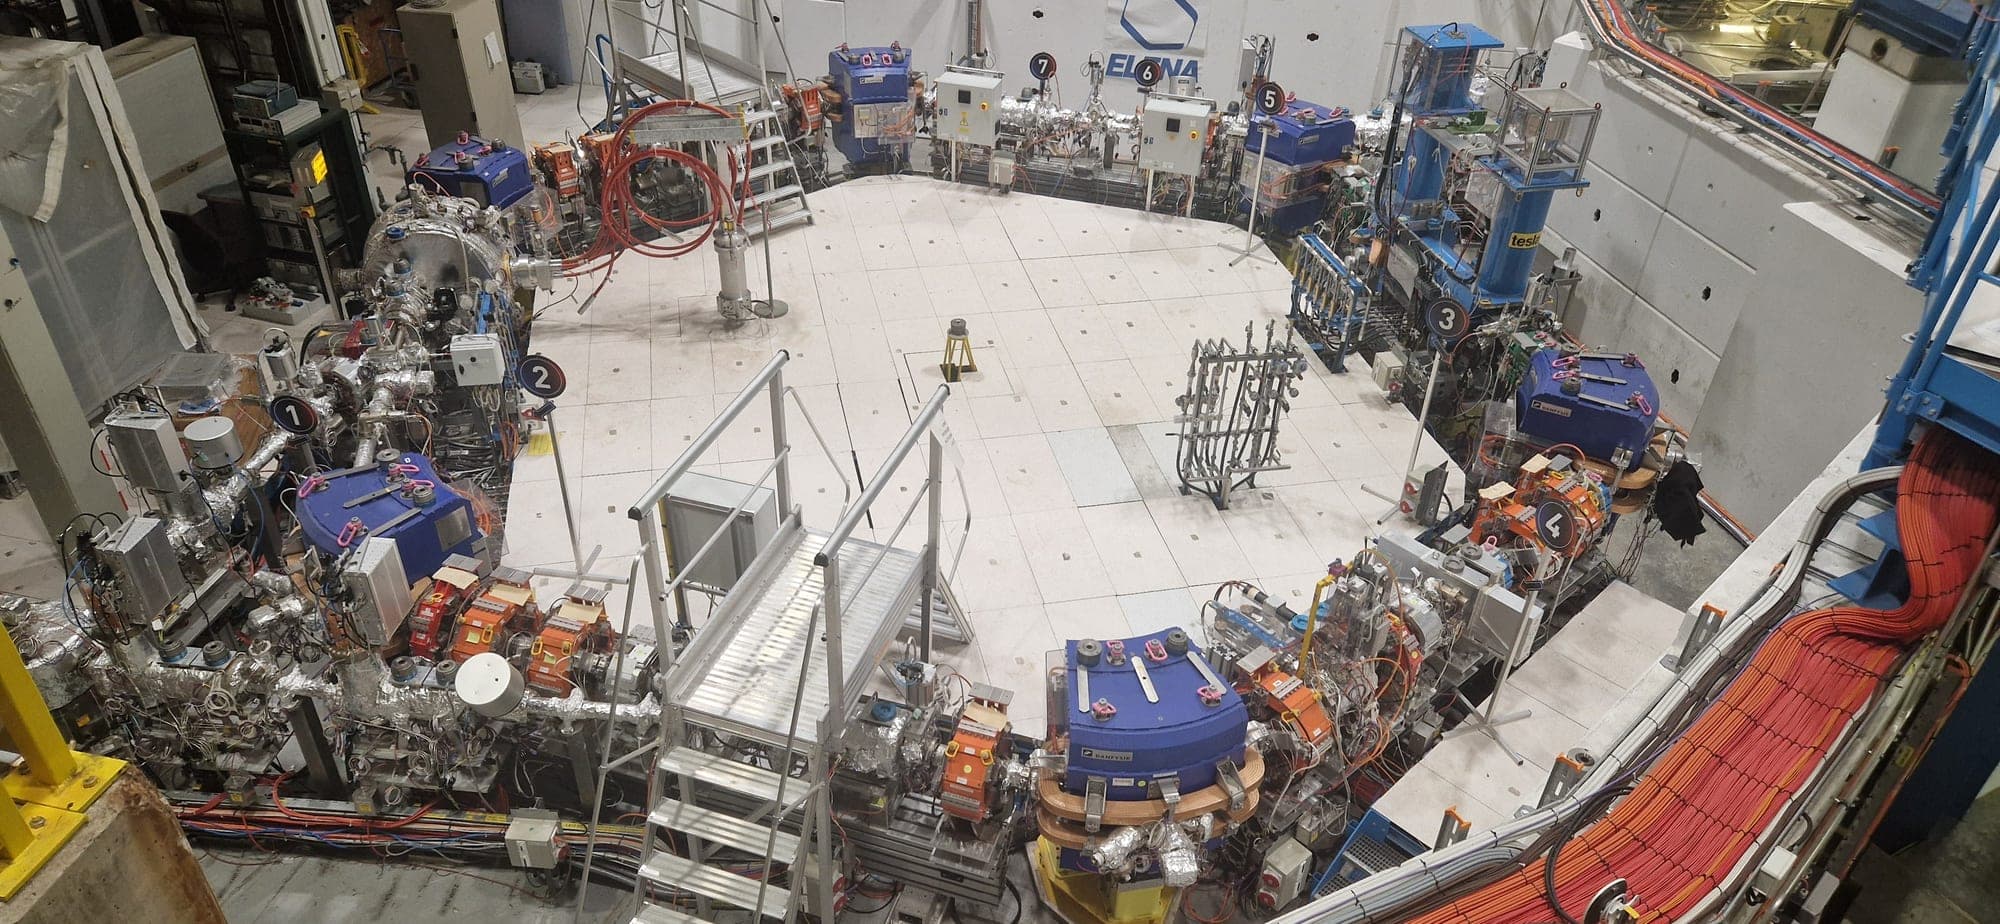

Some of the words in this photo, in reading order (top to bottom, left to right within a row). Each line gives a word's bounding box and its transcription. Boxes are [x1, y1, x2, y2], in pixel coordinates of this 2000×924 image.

[1038, 59, 1049, 74] 7
[1142, 65, 1153, 81] 6
[1264, 90, 1276, 108] 5
[1438, 307, 1455, 330] 3
[532, 365, 551, 389] 2
[285, 405, 300, 426] 1
[1545, 512, 1563, 539] 4
